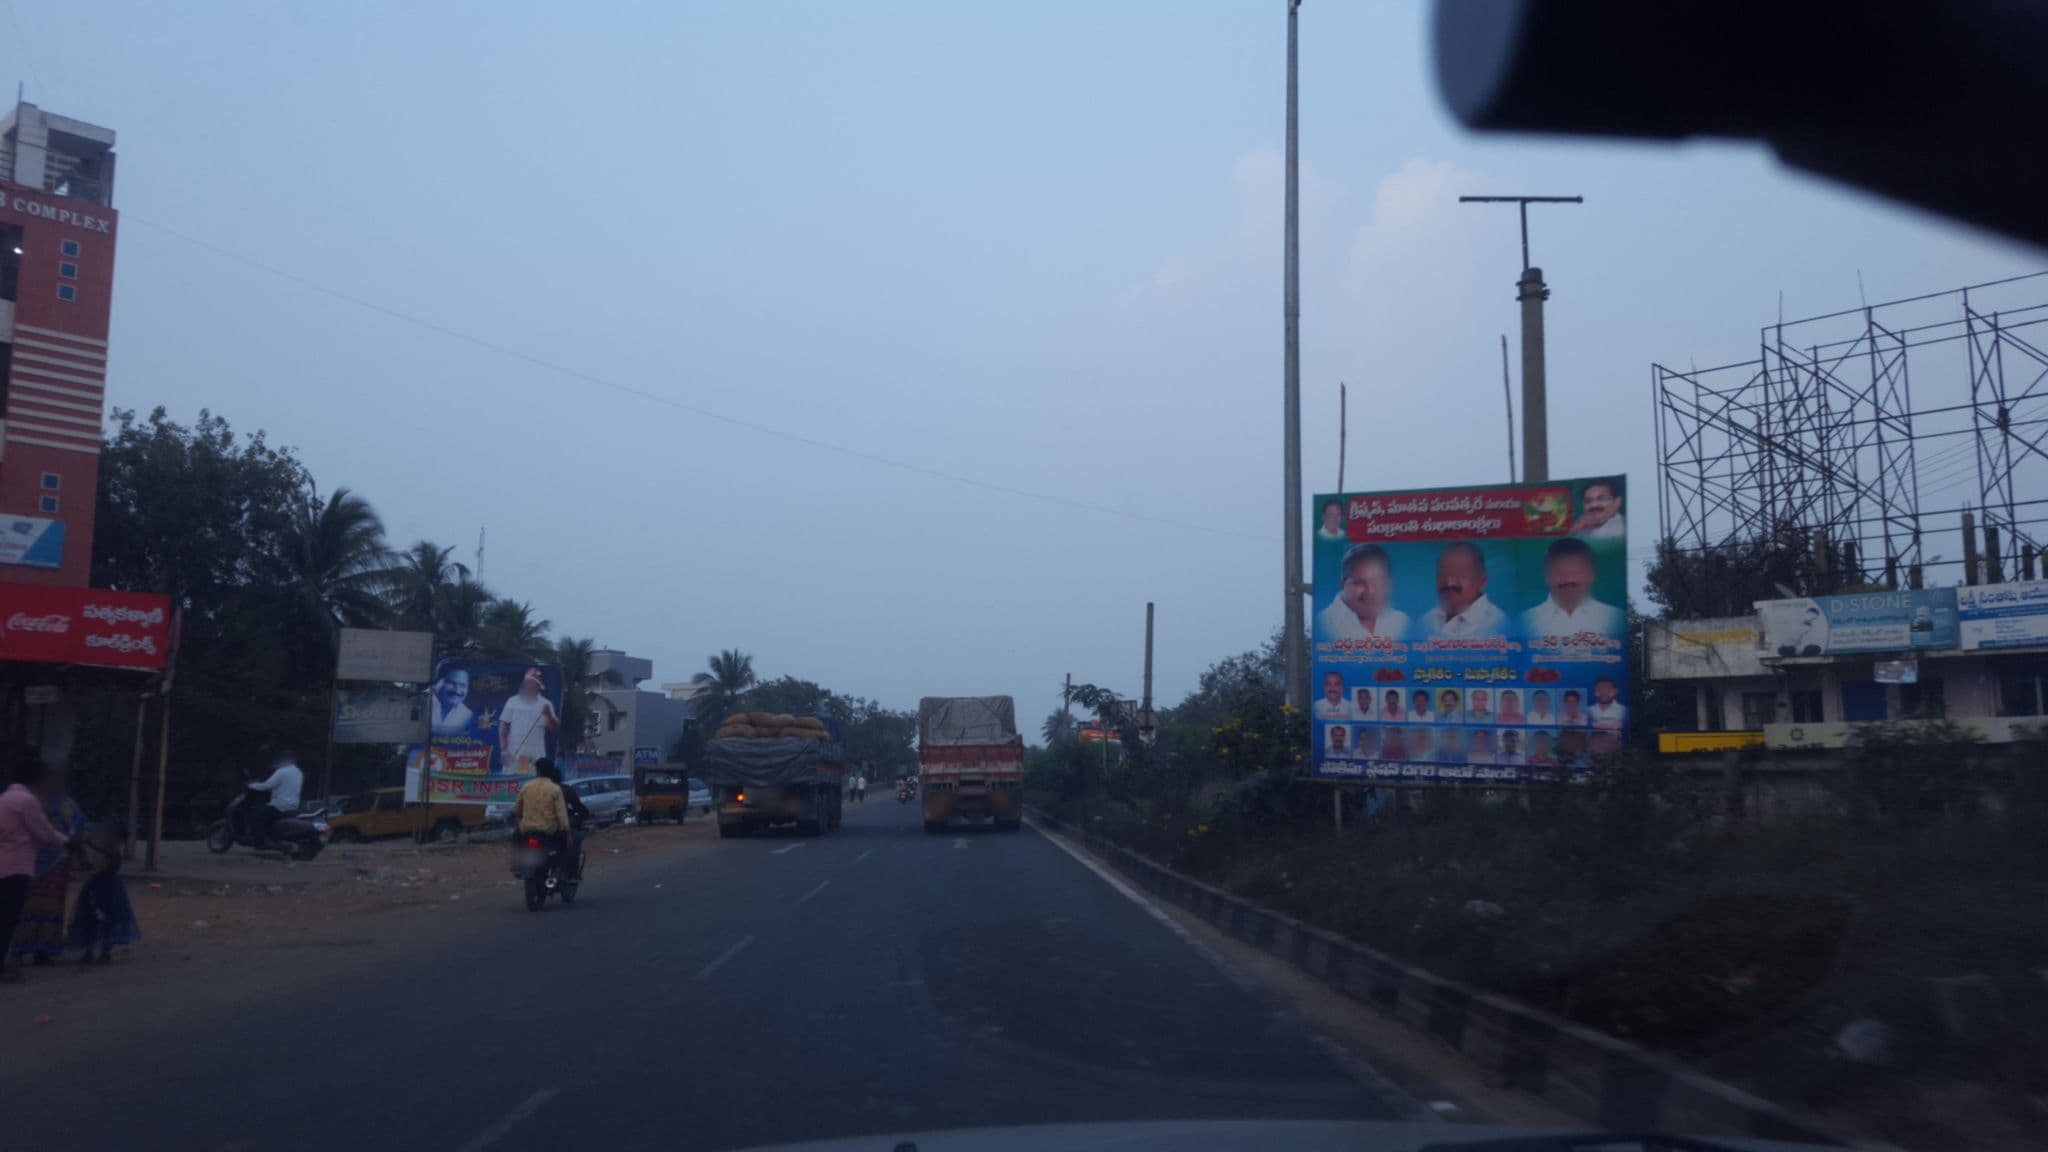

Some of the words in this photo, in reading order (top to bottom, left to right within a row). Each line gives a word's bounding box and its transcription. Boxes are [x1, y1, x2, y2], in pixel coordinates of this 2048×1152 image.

[13, 197, 111, 233] COMPLEX
[1831, 593, 1914, 613] D-STONE
[635, 750, 658, 761] ATM
[472, 779, 521, 794] INFR
